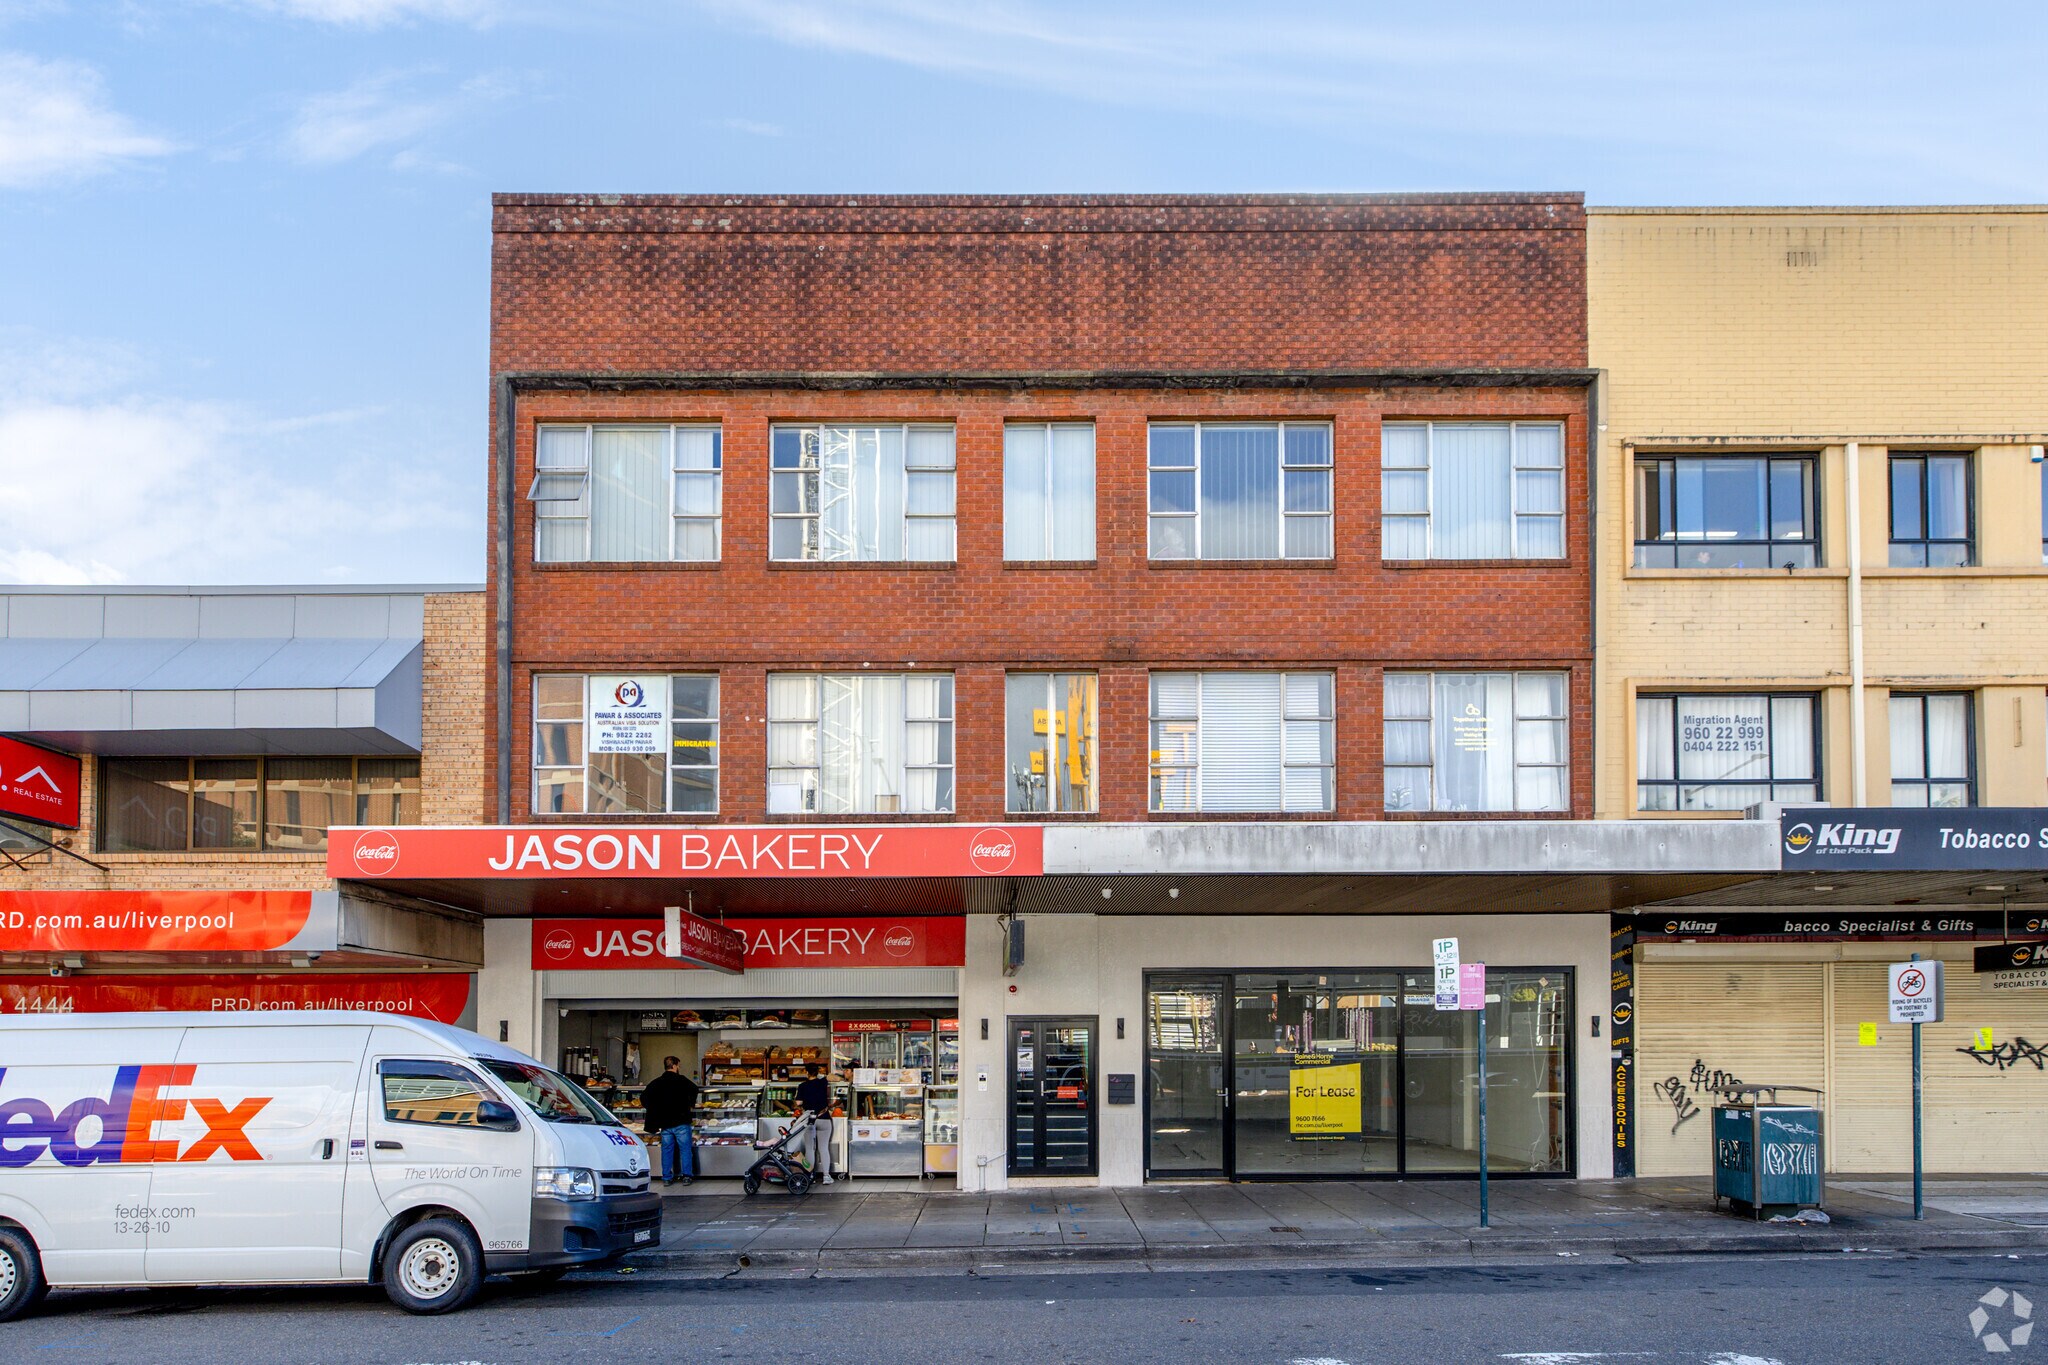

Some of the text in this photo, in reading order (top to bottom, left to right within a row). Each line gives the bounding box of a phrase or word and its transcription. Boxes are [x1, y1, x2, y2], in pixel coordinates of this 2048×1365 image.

[1683, 714, 1763, 726] Migration Agent
[1684, 727, 1764, 740] 960 22 999
[674, 740, 717, 748] IMMIGRATION
[1683, 740, 1764, 752] 0404 222 151
[13, 786, 62, 806] REAL ESTATE
[1816, 823, 1902, 854] King
[1939, 828, 2030, 849] Tobacco
[356, 834, 1011, 871] Coca-Cola JASON BAKERY Coca-Cola
[688, 920, 712, 944] JASON
[1610, 925, 1632, 938] SNACKS
[1679, 921, 1718, 934] King
[1838, 920, 1915, 934] Specialist
[1921, 920, 1932, 931] &
[1937, 919, 1974, 931] Gifts
[545, 939, 572, 950] Coca-Cola
[583, 930, 666, 957] JAS
[885, 936, 912, 947] Coca-Cola
[1438, 941, 1453, 953] 1P
[1611, 948, 1632, 960] DRINKS
[1440, 968, 1455, 979] 1P
[1611, 974, 1629, 984] PHONE
[1613, 970, 1624, 978] ALL
[1995, 970, 2046, 980] TOBACCO
[1612, 980, 1630, 990] CARDS
[1994, 980, 2040, 988] SPECIALIST
[14, 997, 74, 1014] 4444
[211, 998, 413, 1011] PRD.com.au/liverpool
[1612, 1036, 1630, 1046] GIFTS
[1296, 1086, 1356, 1098] For Lease
[1616, 1066, 1626, 1148] ACCESSORIES
[0, 1065, 273, 1167] edEx
[601, 1130, 638, 1146] FedEx
[404, 1166, 522, 1180] The World On Time
[114, 1204, 196, 1219] fedex.com
[113, 1221, 170, 1234] 13-26-10
[488, 1240, 523, 1250] 965766
